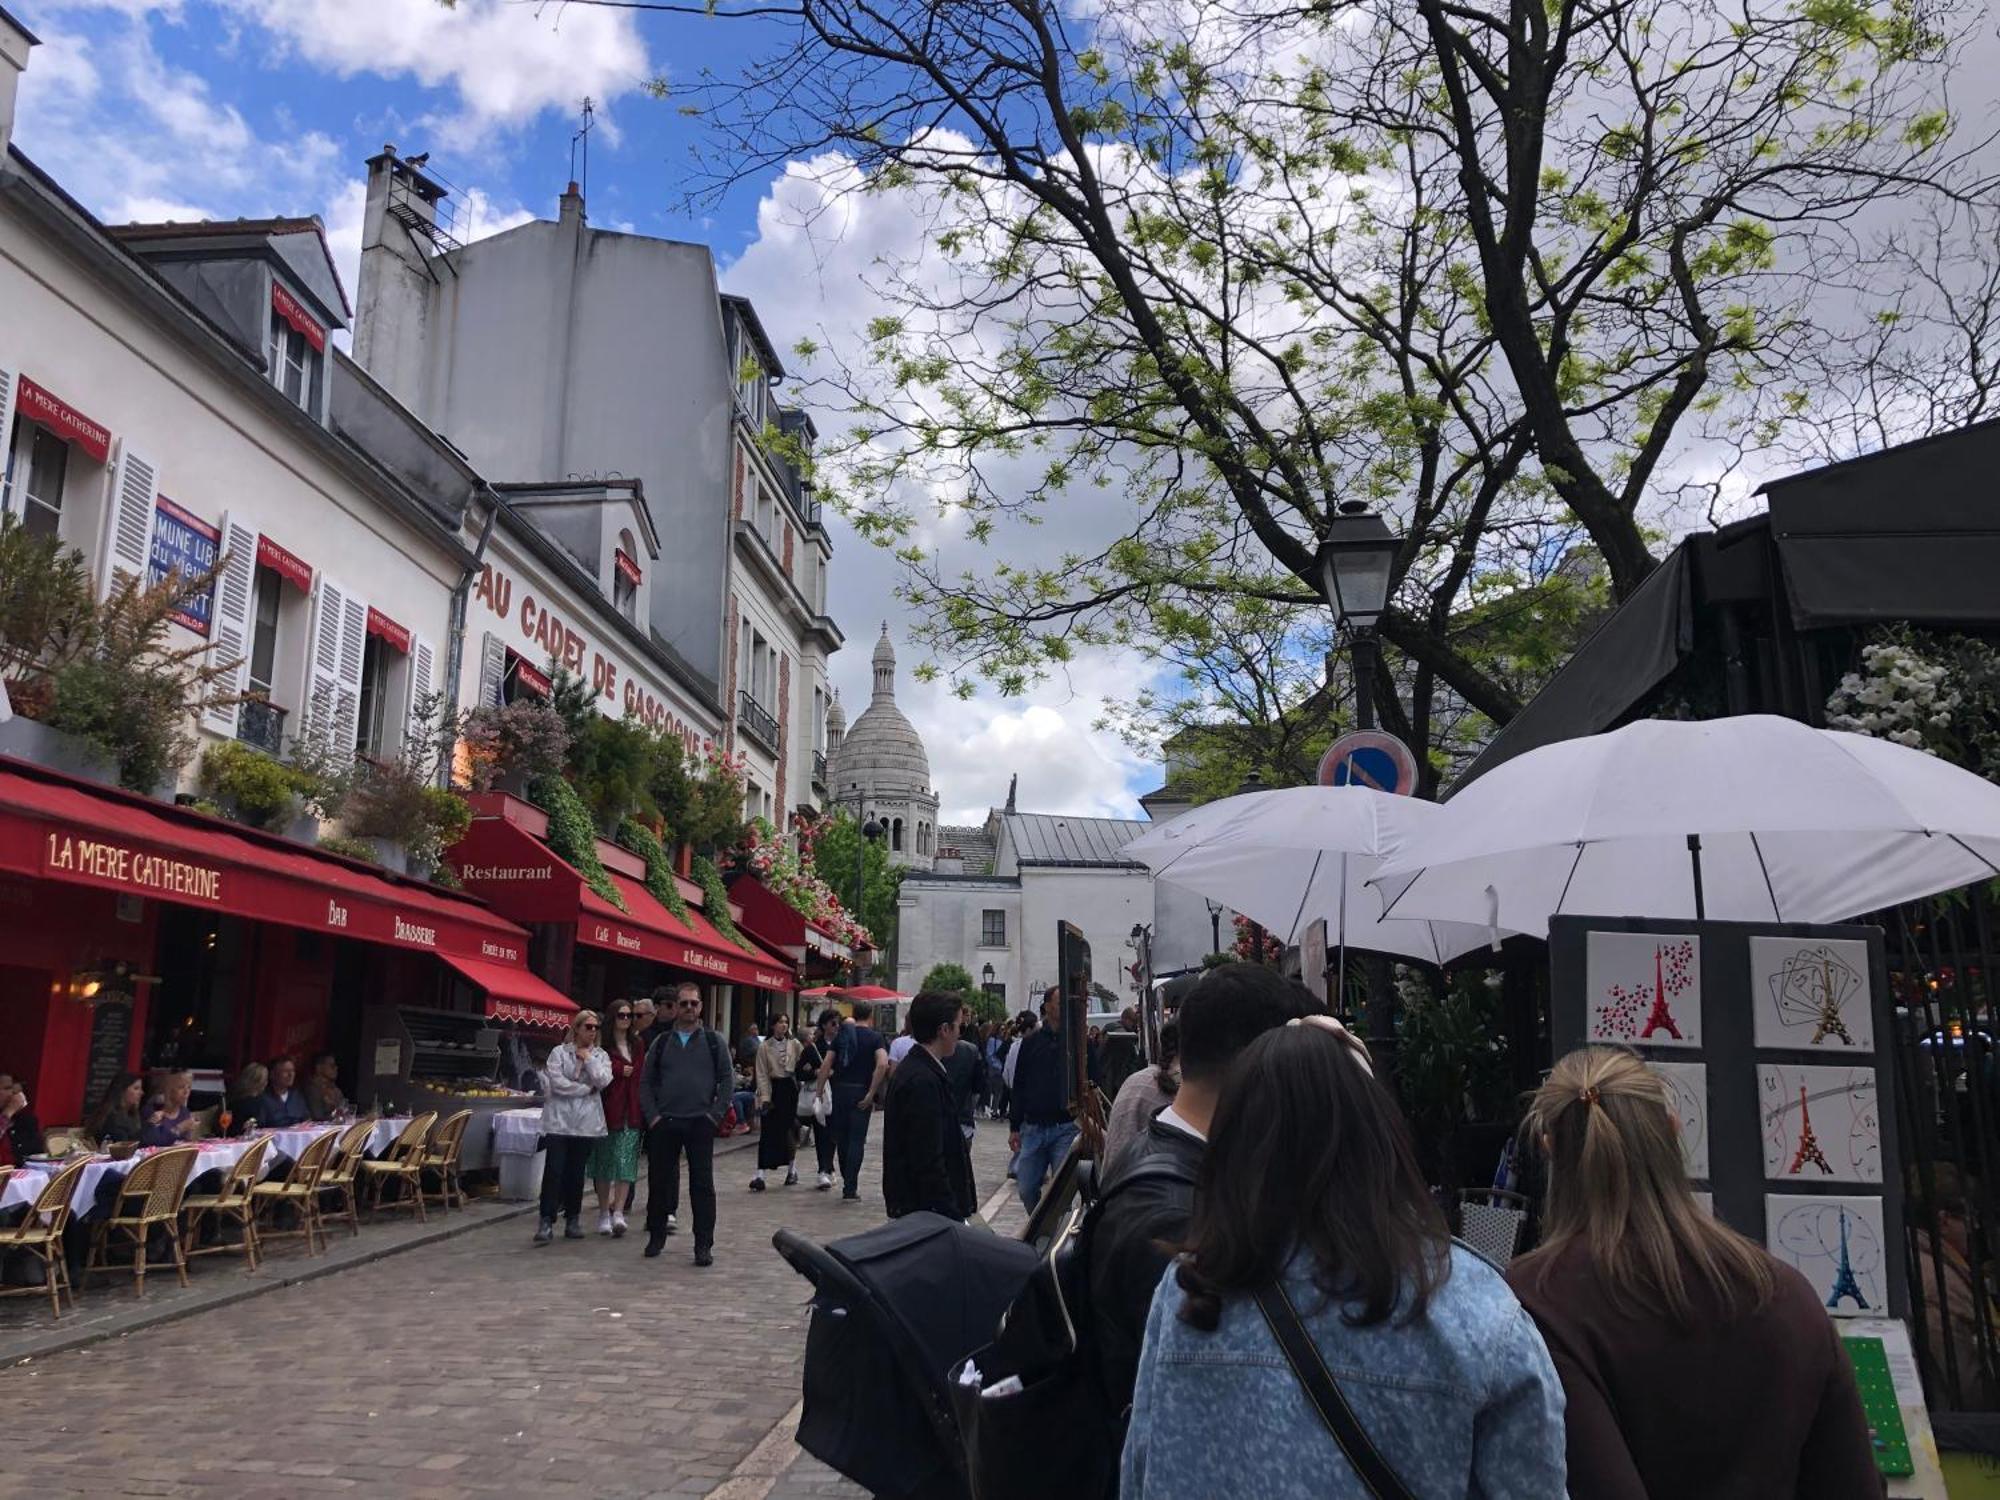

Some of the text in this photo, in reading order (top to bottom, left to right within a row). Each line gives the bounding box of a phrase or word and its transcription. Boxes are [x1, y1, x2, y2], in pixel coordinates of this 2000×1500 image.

[20, 382, 32, 400] LA
[60, 410, 107, 447] CATHERINE
[151, 539, 168, 565] du
[476, 562, 512, 619] AU
[521, 595, 586, 676] CADET
[593, 652, 617, 701] DE
[49, 833, 221, 900] LA MERE CATHERINE
[463, 864, 552, 881] Restaurant
[328, 900, 348, 927] BAR
[394, 915, 436, 946] BRASSERIE
